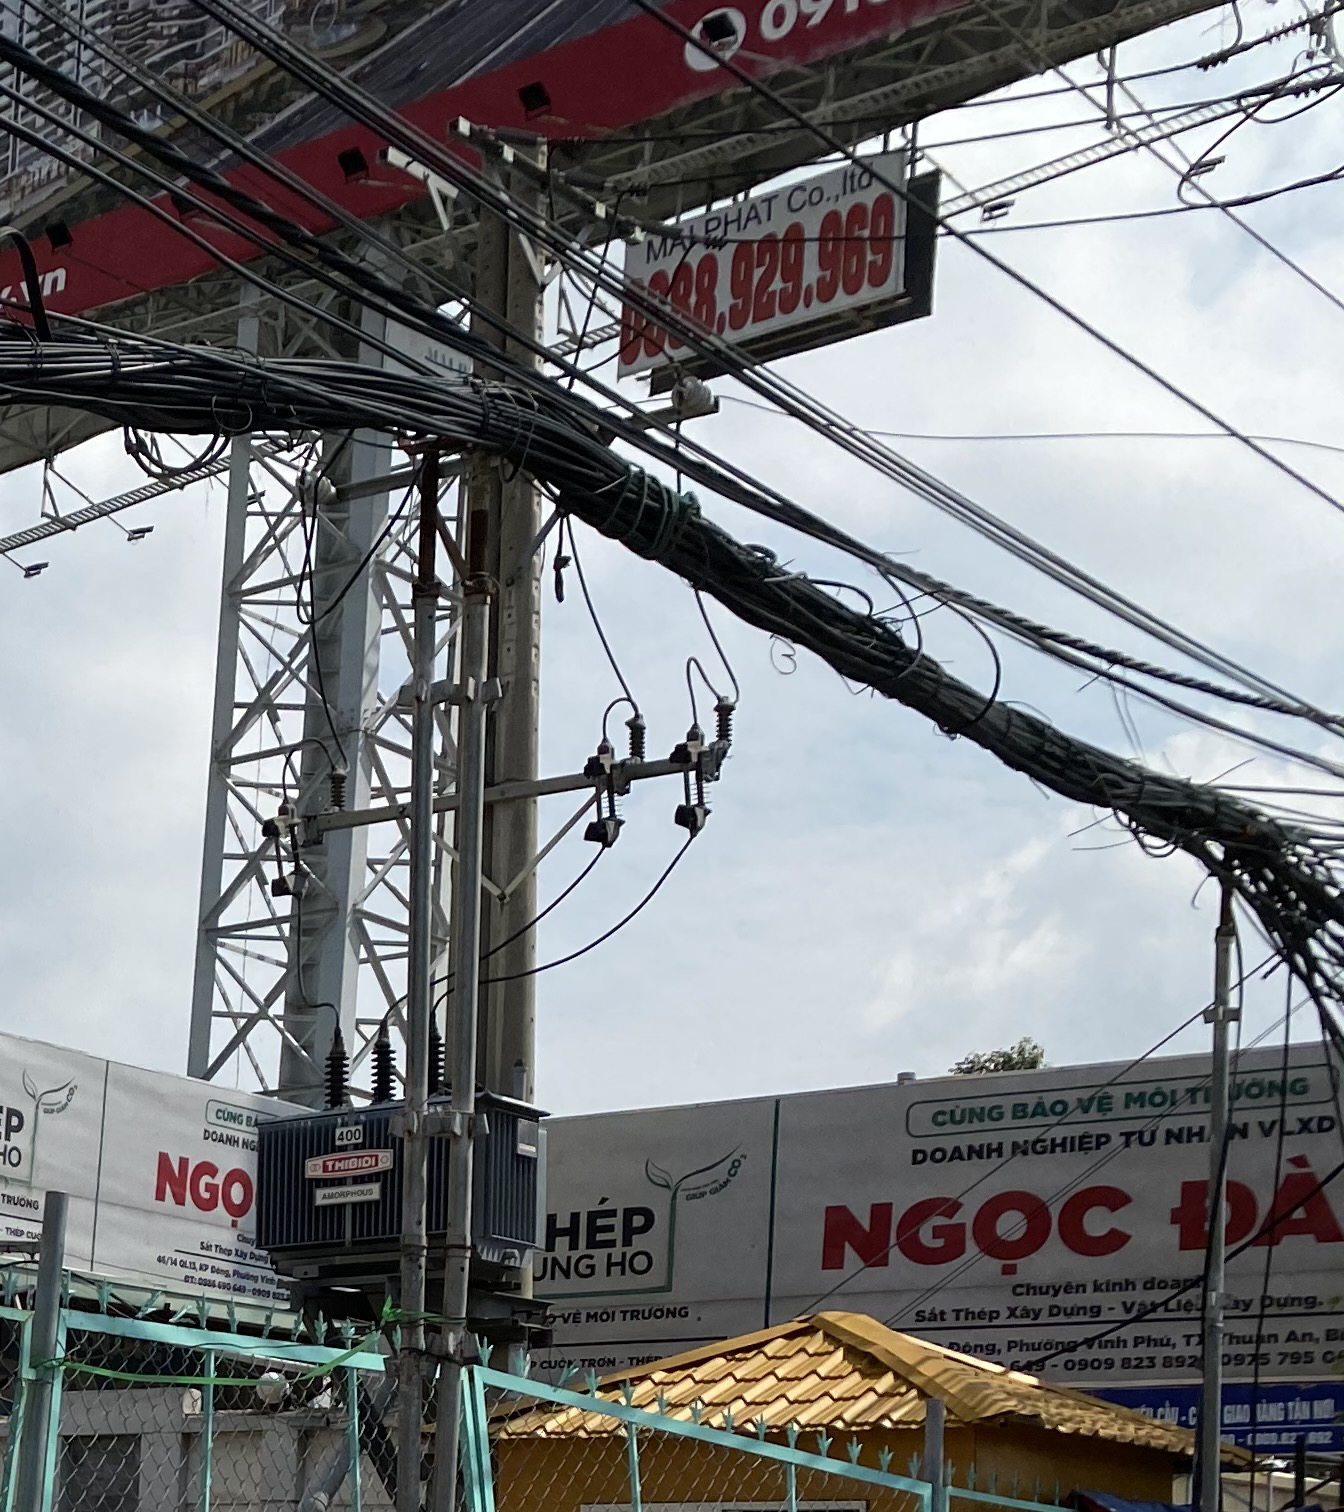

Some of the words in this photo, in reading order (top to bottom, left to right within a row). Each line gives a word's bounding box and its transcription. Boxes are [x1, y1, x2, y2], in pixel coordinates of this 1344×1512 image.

[931, 1102, 1005, 1127] CÙNG
[1012, 1095, 1069, 1121] BẢO
[1077, 1089, 1113, 1117] VỆ
[1125, 1083, 1177, 1110] MÔI
[203, 1128, 239, 1147] DOANH
[337, 1128, 361, 1142] 400
[912, 1136, 1004, 1166] DOANH
[1012, 1131, 1111, 1158] NGHIỆP
[325, 1155, 376, 1171] THIBIDI
[155, 1151, 253, 1228] NGỌ
[322, 1188, 373, 1201] AMORPHOUS
[545, 1196, 655, 1252] HÉP
[820, 1184, 1134, 1276] NGỌC
[534, 1253, 596, 1282] UNG
[606, 1250, 653, 1277] HO
[1012, 1279, 1087, 1299] Chuyên
[1093, 1276, 1137, 1294] kinh
[915, 1306, 947, 1324] Sắt
[953, 1304, 1000, 1324] Thép
[1005, 1302, 1042, 1321] Xây
[1064, 1357, 1115, 1371] 0909
[1120, 1356, 1156, 1369] 823
[1163, 1355, 1197, 1368] 892
[1278, 1351, 1315, 1365] 795
